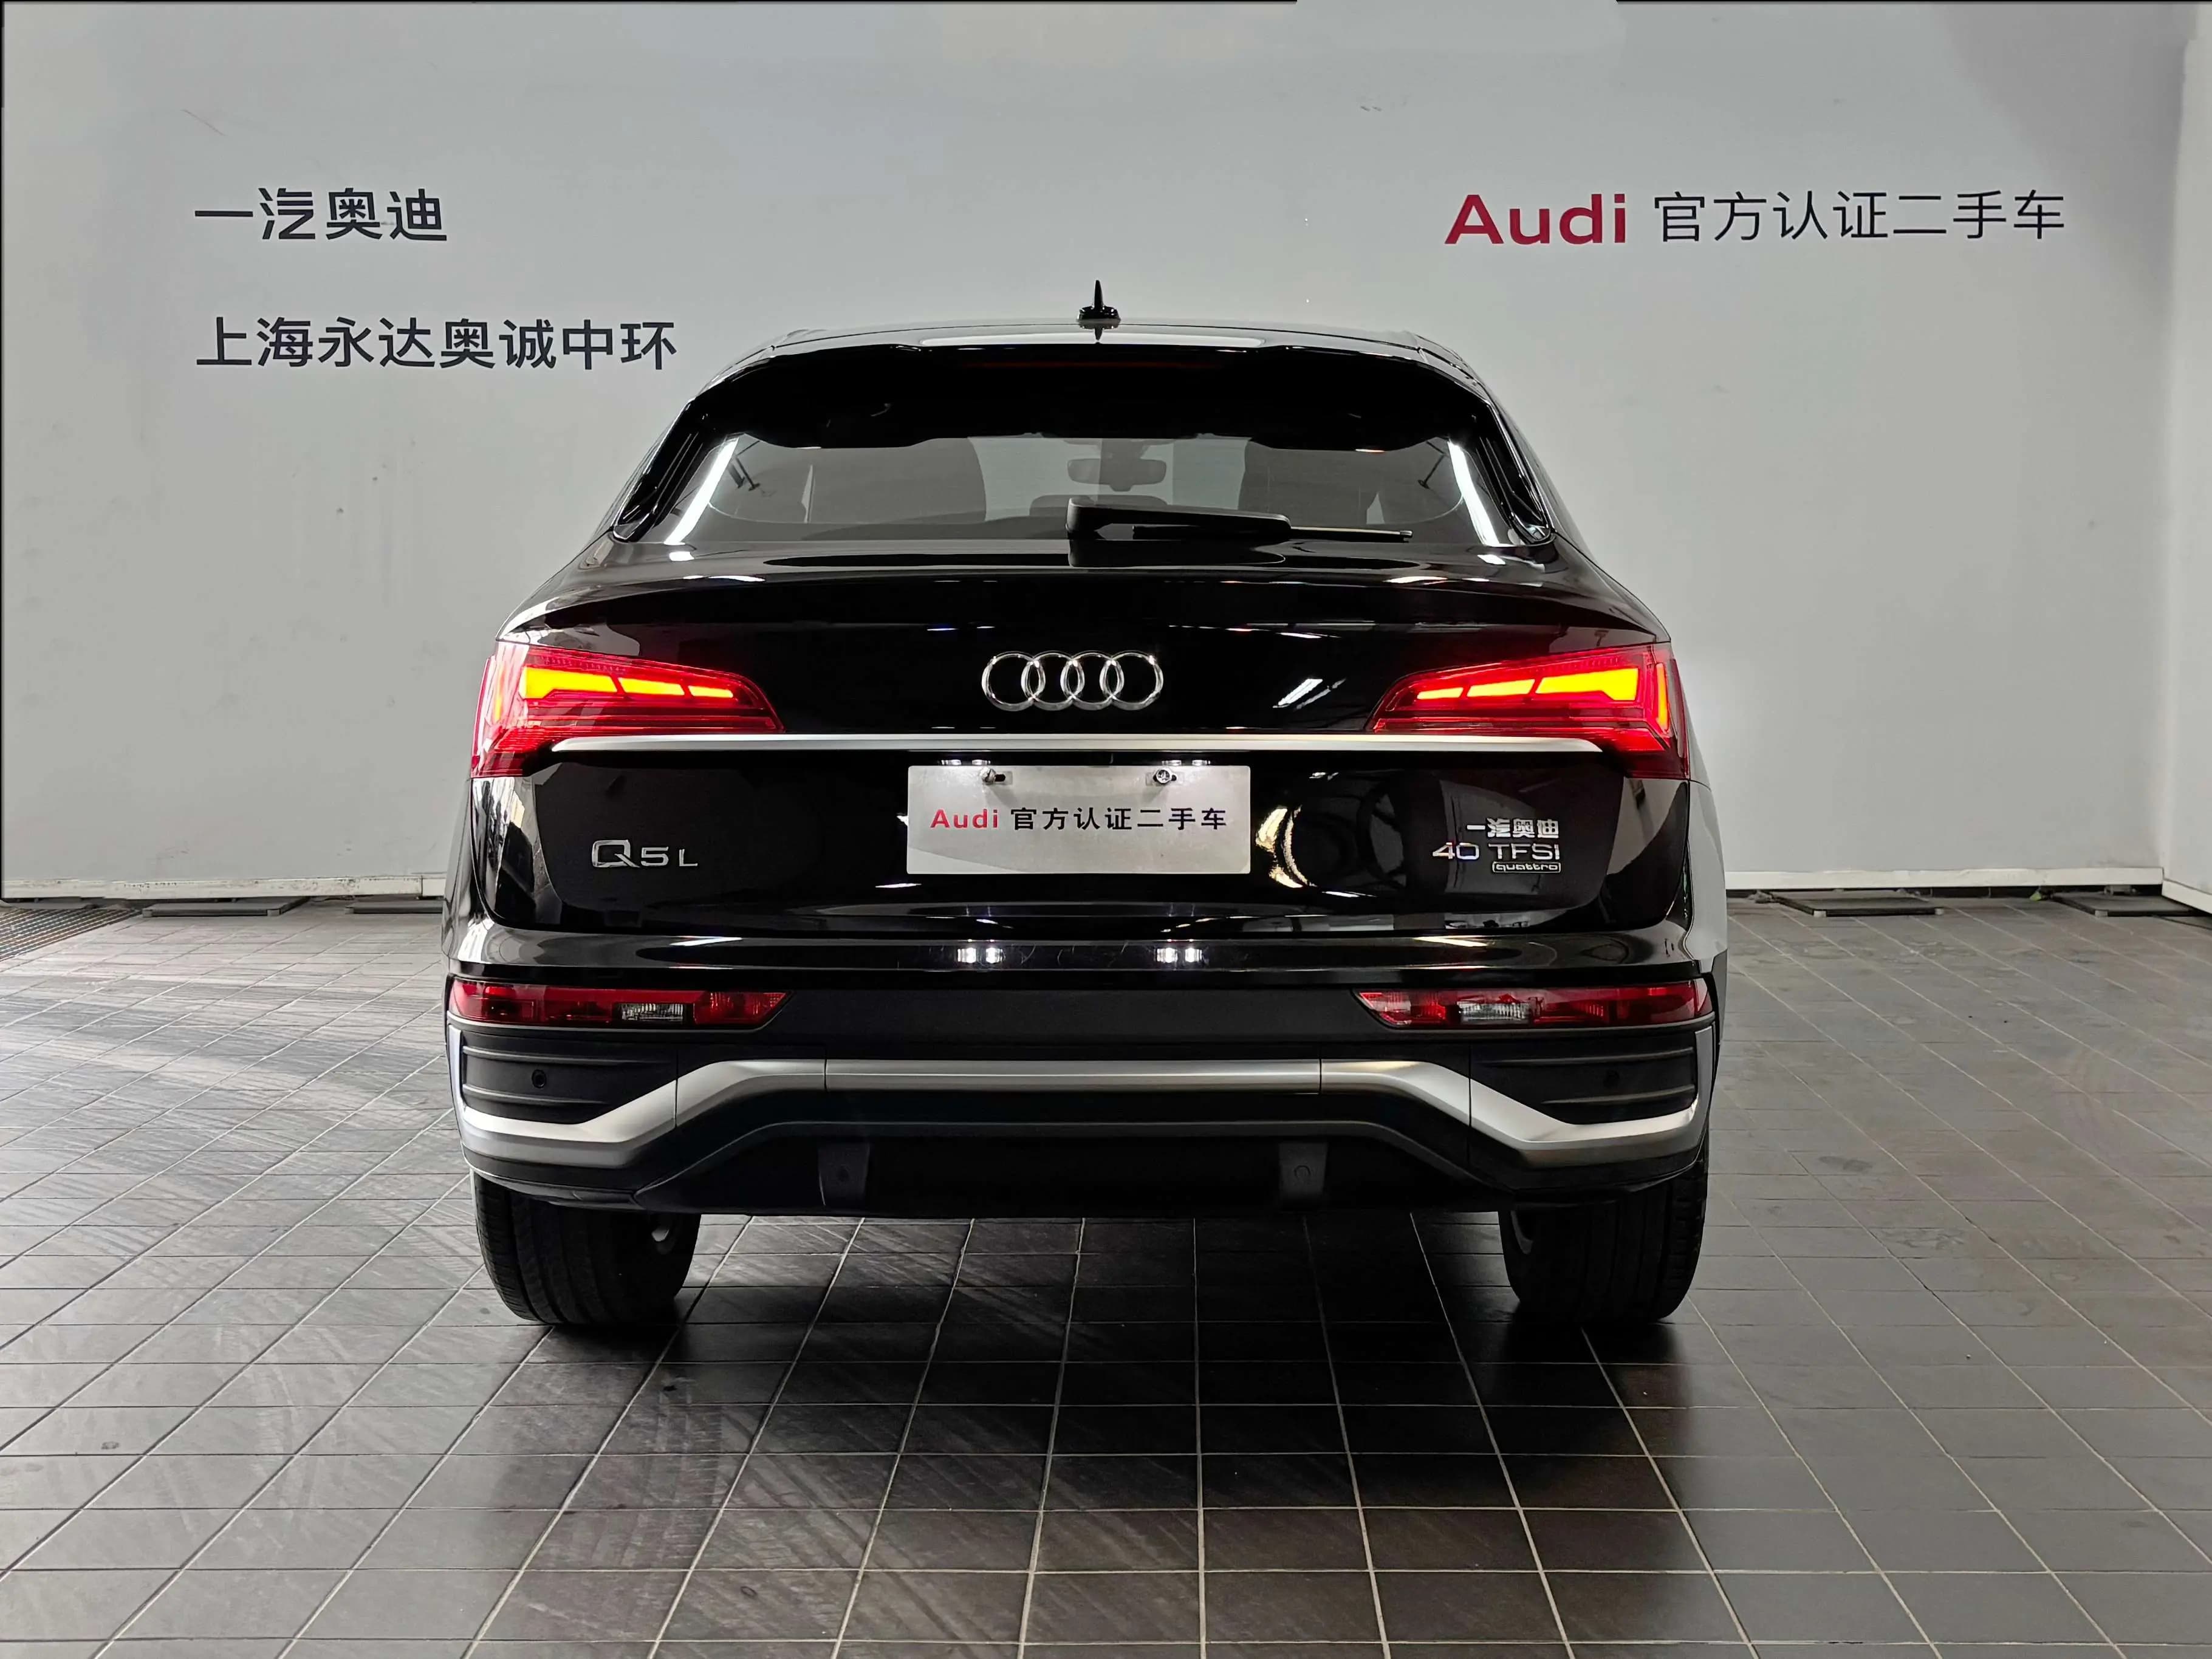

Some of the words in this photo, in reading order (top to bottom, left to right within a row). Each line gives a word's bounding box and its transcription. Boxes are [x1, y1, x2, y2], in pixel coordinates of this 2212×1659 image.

[194, 187, 447, 241] 一汽奥迪
[1445, 193, 1626, 245] Audi
[1654, 189, 2064, 242] 官方认证二手车
[196, 316, 677, 370] 上海永达奥诚中环
[930, 809, 998, 829] Audi
[1010, 807, 1227, 830] 官方认证二手车
[1467, 818, 1559, 839] 一汽奥迪
[1432, 842, 1480, 860] 40
[1488, 843, 1560, 860] TFSI
[1496, 863, 1559, 872] quattro
